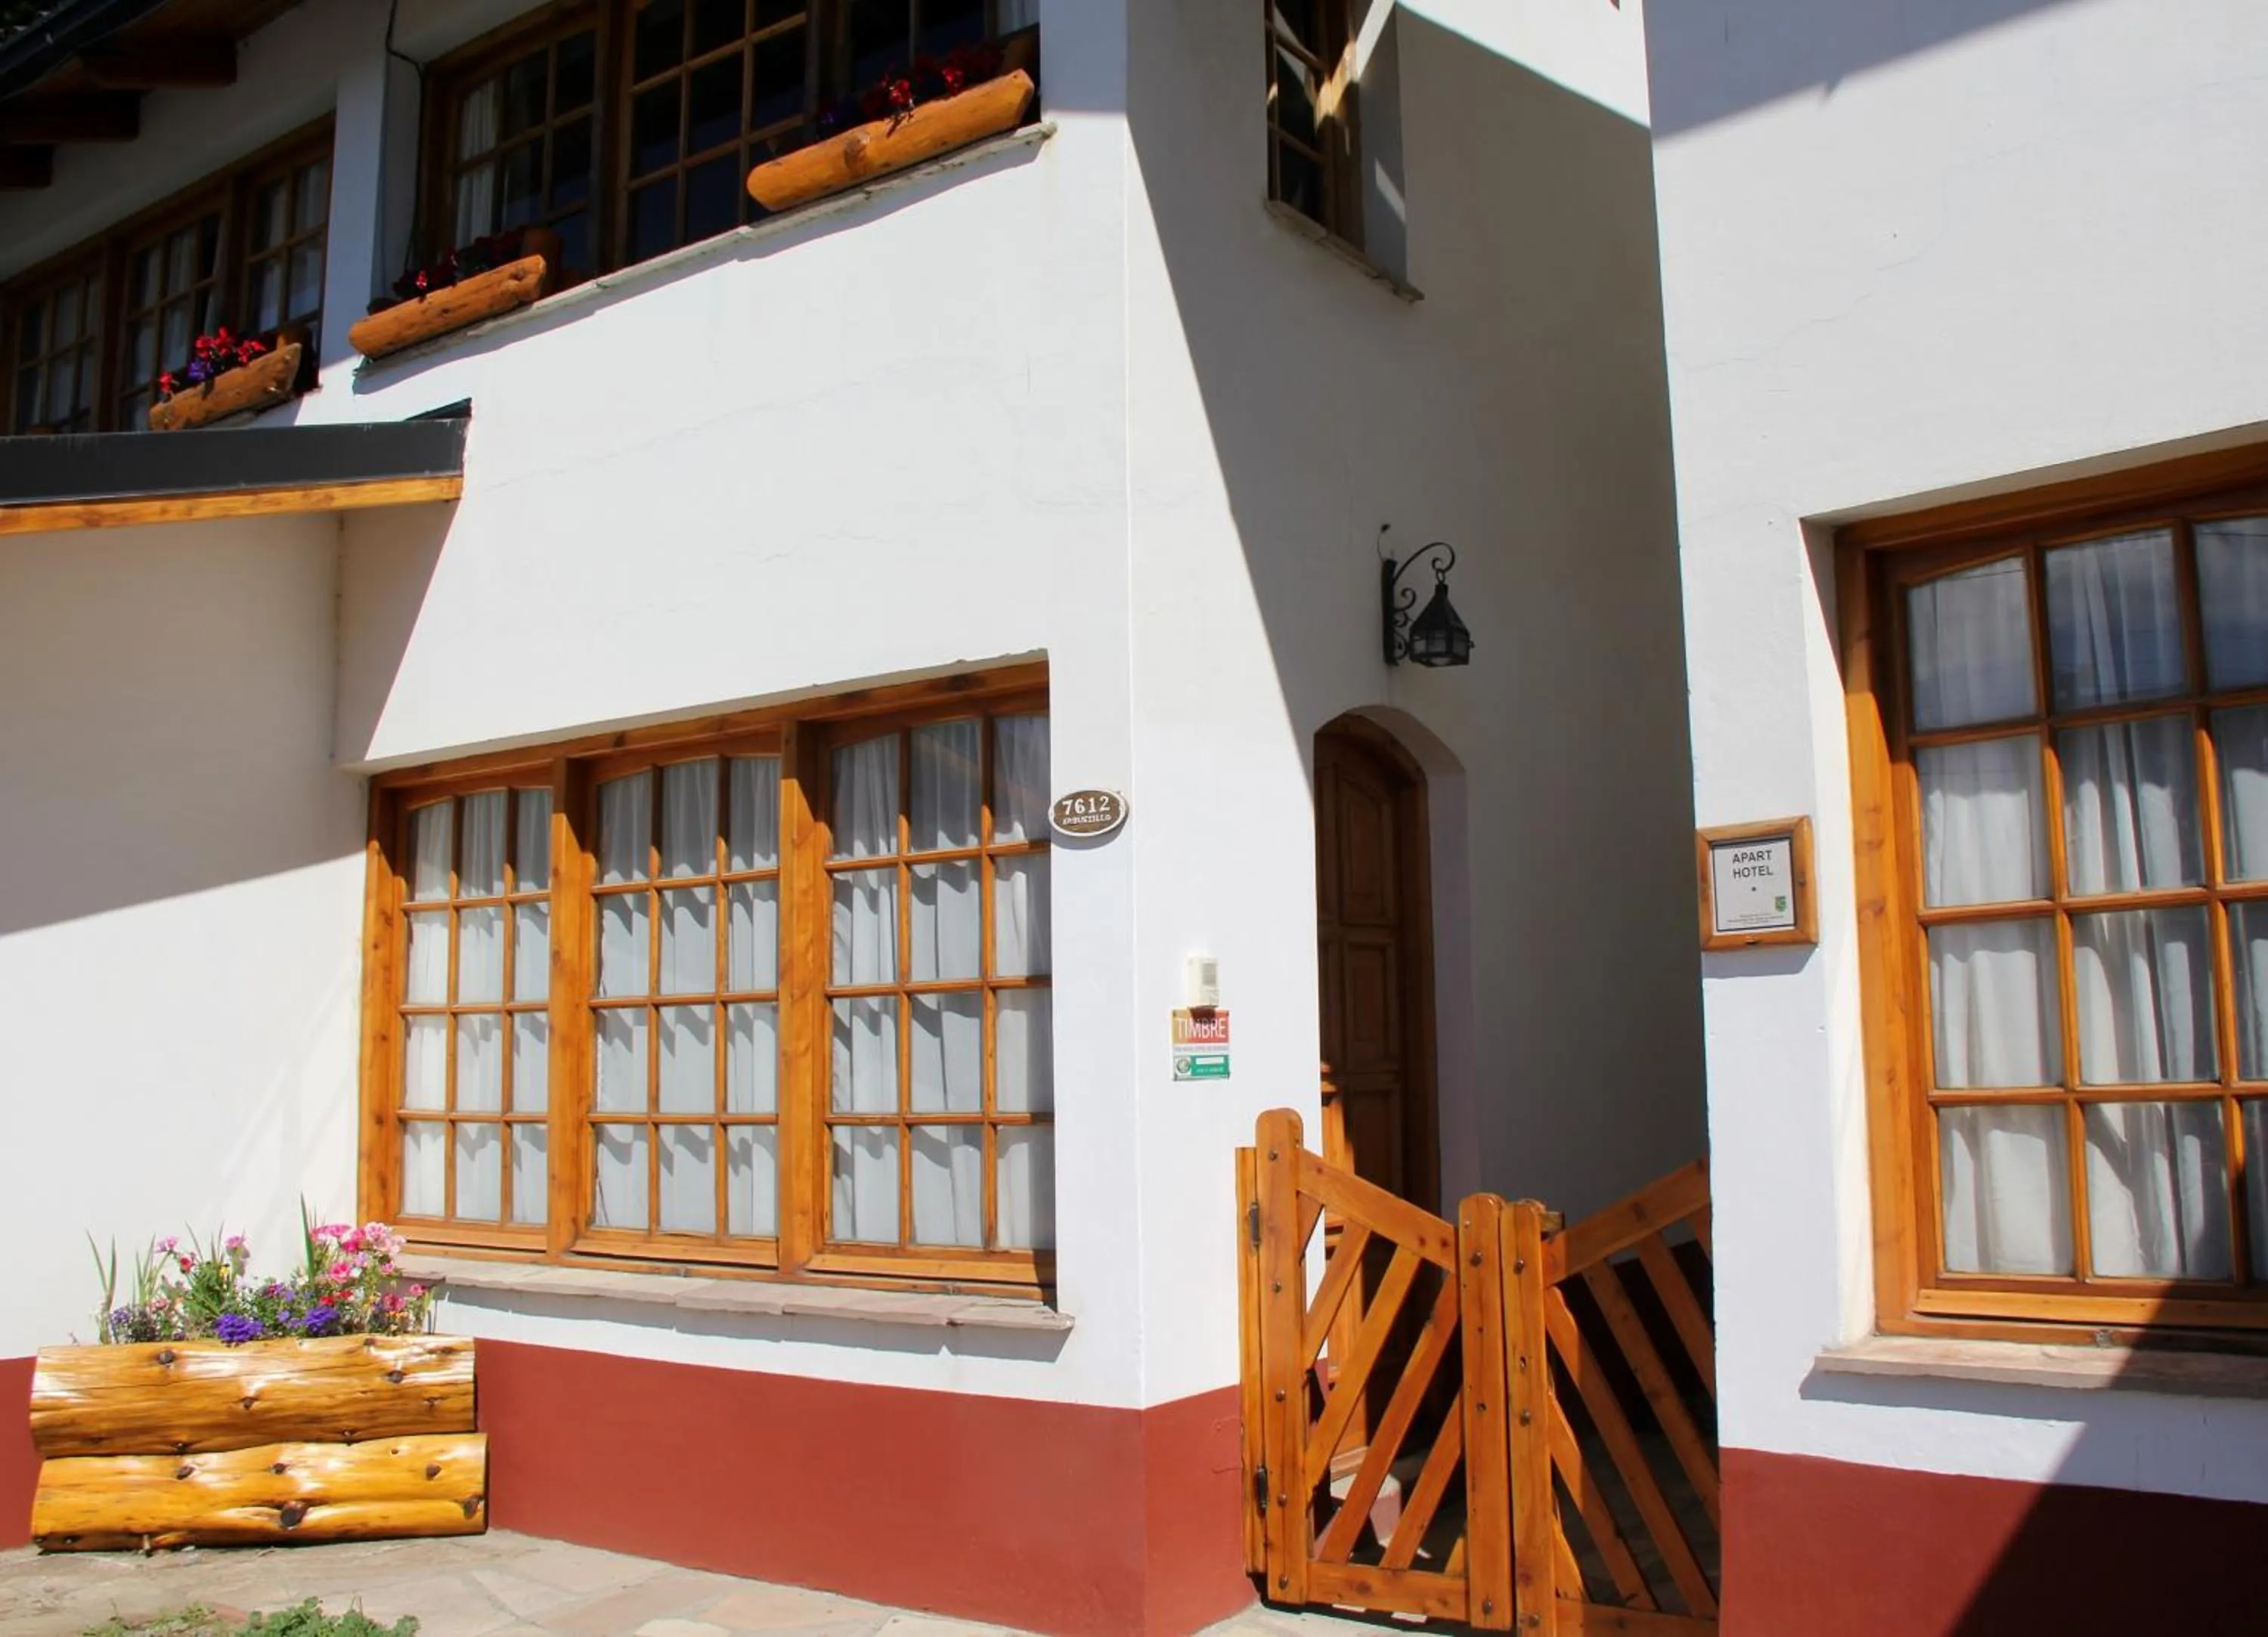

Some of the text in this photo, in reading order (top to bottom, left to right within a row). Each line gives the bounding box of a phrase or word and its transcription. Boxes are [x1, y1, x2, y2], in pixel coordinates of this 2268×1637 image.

[1061, 796, 1111, 815] 7612
[1732, 850, 1772, 864] APART
[1733, 865, 1774, 879] HOTEL
[1176, 1018, 1226, 1039] TIMBRE
